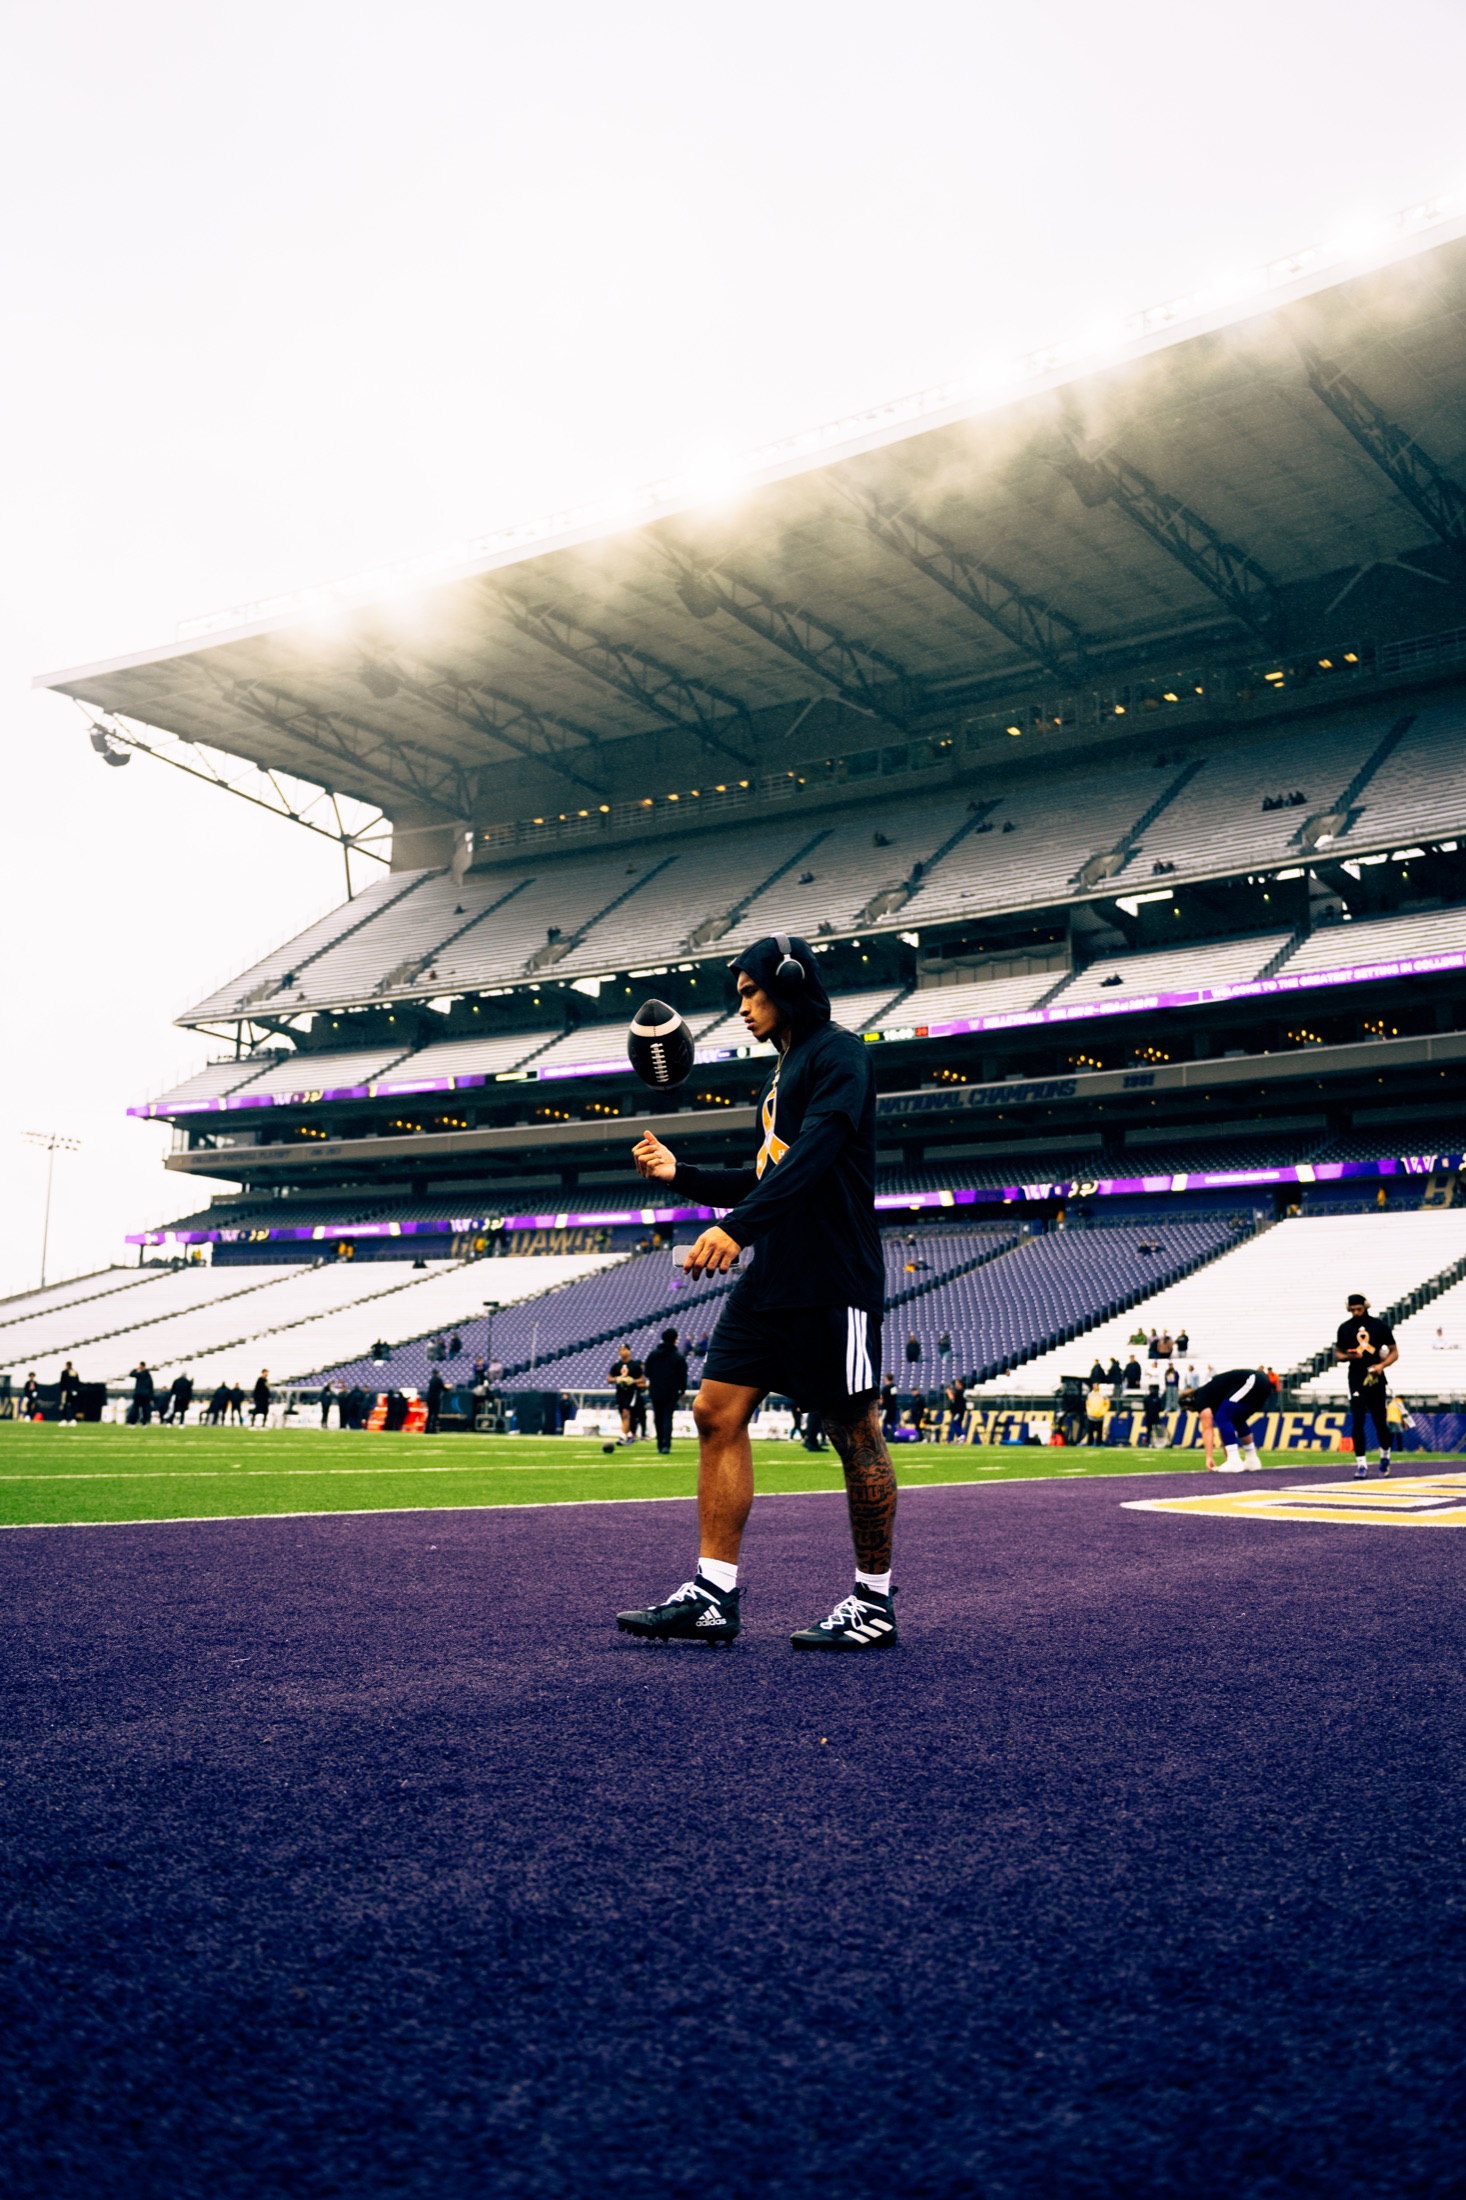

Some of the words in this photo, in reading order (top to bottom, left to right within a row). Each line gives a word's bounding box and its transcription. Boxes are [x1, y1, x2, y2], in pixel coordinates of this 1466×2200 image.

[1211, 982, 1261, 998] WELCOME
[1261, 980, 1277, 992] TO
[1278, 977, 1298, 990] THE
[1299, 968, 1353, 987] GREATEST
[1353, 963, 1399, 980] SETTING
[1400, 961, 1413, 973] IN
[1413, 954, 1464, 972] COLLEGE
[879, 1088, 964, 1116] NATIONAL
[968, 1079, 1078, 1106] CHAMPIONS
[1400, 1154, 1438, 1174] W
[695, 1617, 727, 1627] adidas
